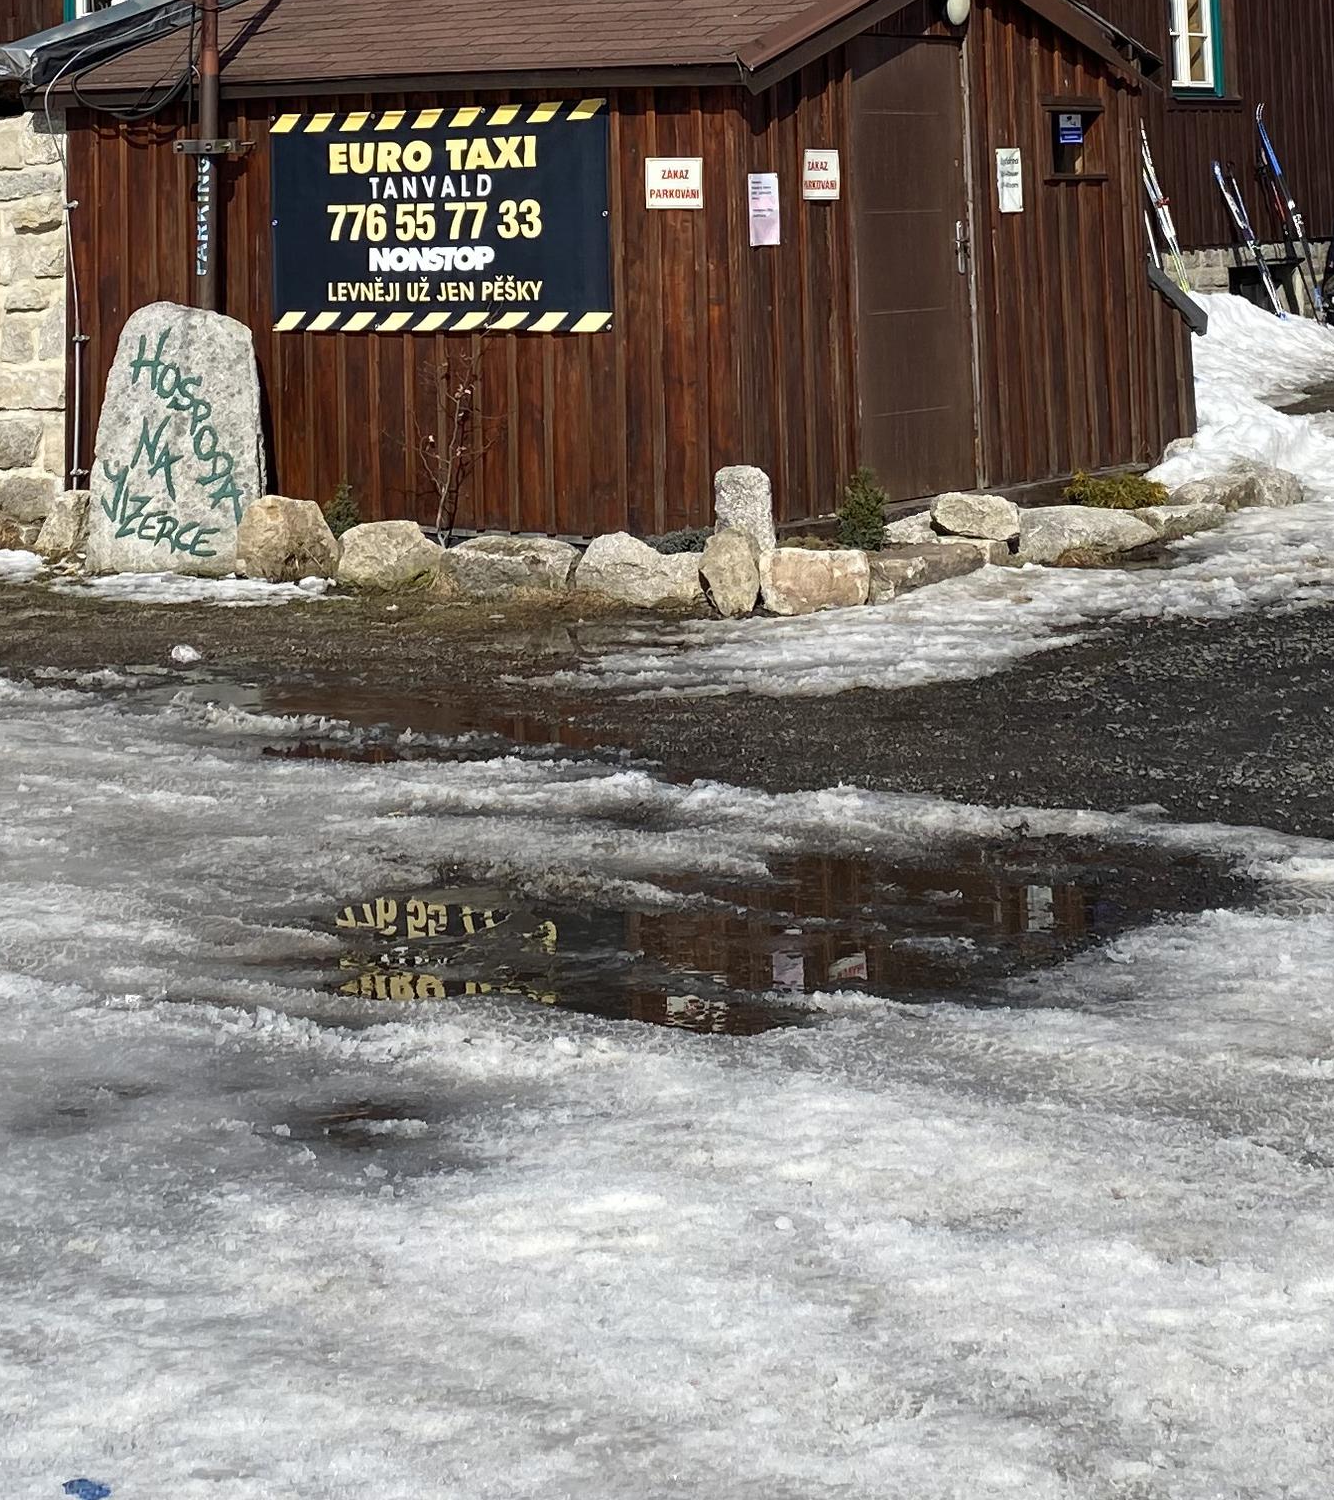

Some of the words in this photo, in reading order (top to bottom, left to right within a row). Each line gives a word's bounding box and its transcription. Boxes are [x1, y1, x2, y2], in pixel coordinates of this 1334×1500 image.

[328, 140, 432, 174] EURO
[445, 135, 537, 171] TAXI
[369, 174, 492, 199] TANVALD
[327, 202, 387, 241] 776
[395, 202, 436, 241] 55
[444, 201, 488, 240] 77
[496, 199, 543, 239] 33
[368, 246, 495, 272] NONSTOP
[328, 276, 400, 302] LEVNĚJI
[407, 277, 431, 302] UŽ
[436, 281, 475, 302] JEN
[481, 275, 543, 301] PĚŠKY
[130, 327, 244, 525] HOSPODA
[130, 415, 184, 502] NA
